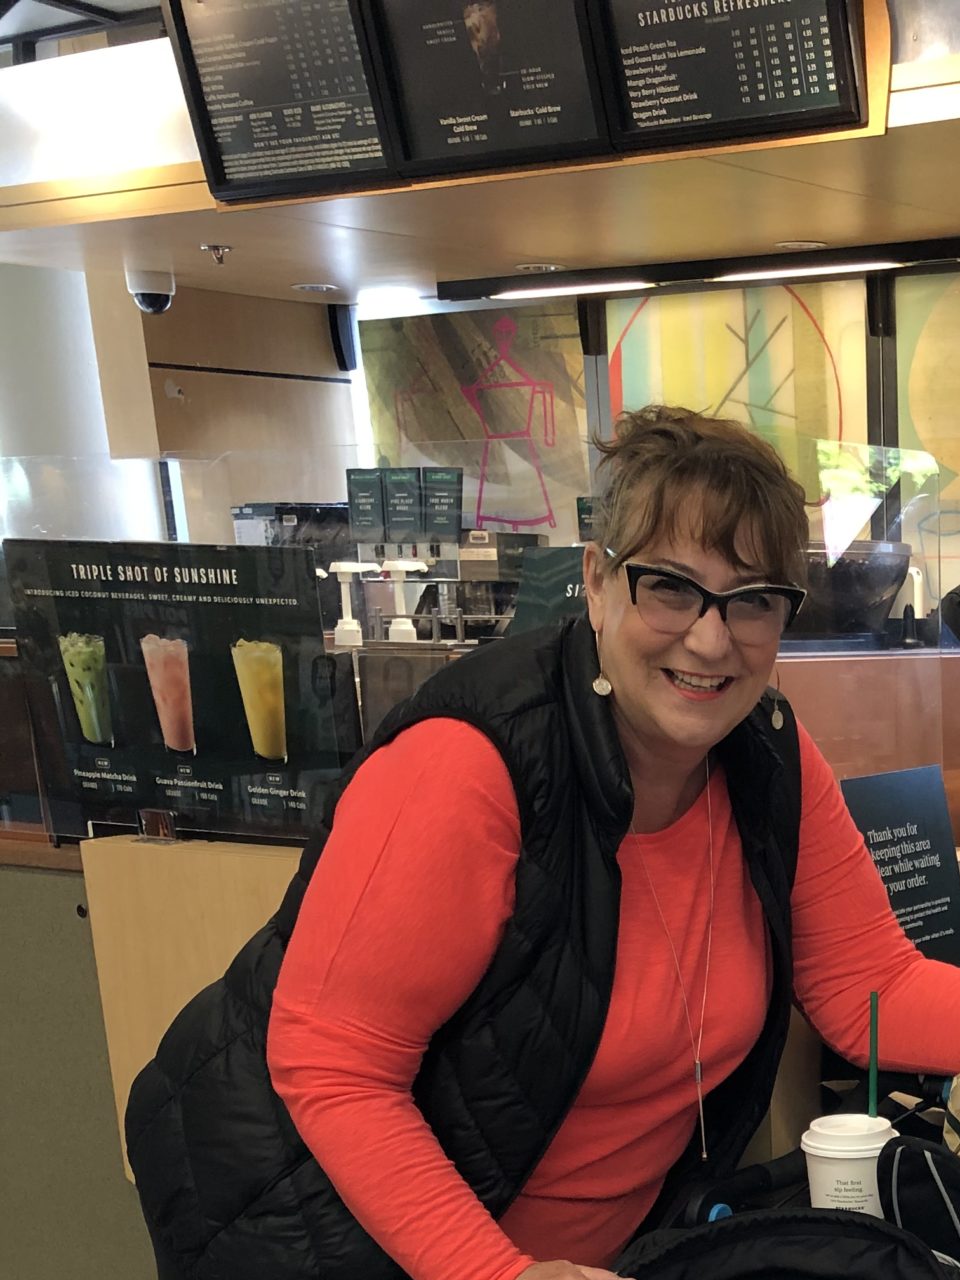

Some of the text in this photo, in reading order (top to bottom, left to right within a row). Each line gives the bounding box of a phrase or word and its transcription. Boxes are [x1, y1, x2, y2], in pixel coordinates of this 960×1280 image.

[638, 2, 708, 27] STARBUCKS
[621, 46, 632, 54] Iced
[633, 44, 649, 52] Peach
[650, 42, 666, 50] Green
[677, 46, 706, 57] Lemonade
[625, 67, 653, 76] Strawberry
[631, 92, 697, 108] Strawberry Coconut Drink
[652, 108, 667, 116] Drink
[440, 117, 456, 125] Vanilla
[71, 564, 238, 585] TRIPLE SHOT OF SUNSHINE
[172, 594, 196, 602] CREAMY
[199, 595, 212, 603] AND
[213, 596, 253, 604] DELICIOUSLY
[256, 598, 299, 606] UNEXPECTED.
[74, 769, 137, 782] Pineapple Matcha Drink
[156, 777, 223, 790] Guava Passionfruit Drink
[248, 786, 306, 798] Golden Ginger Drink
[867, 822, 918, 844] Thank you for
[870, 840, 931, 861] keeping this area
[878, 854, 940, 876] lear while waiting
[890, 880, 906, 896] your
[906, 874, 928, 889] order.
